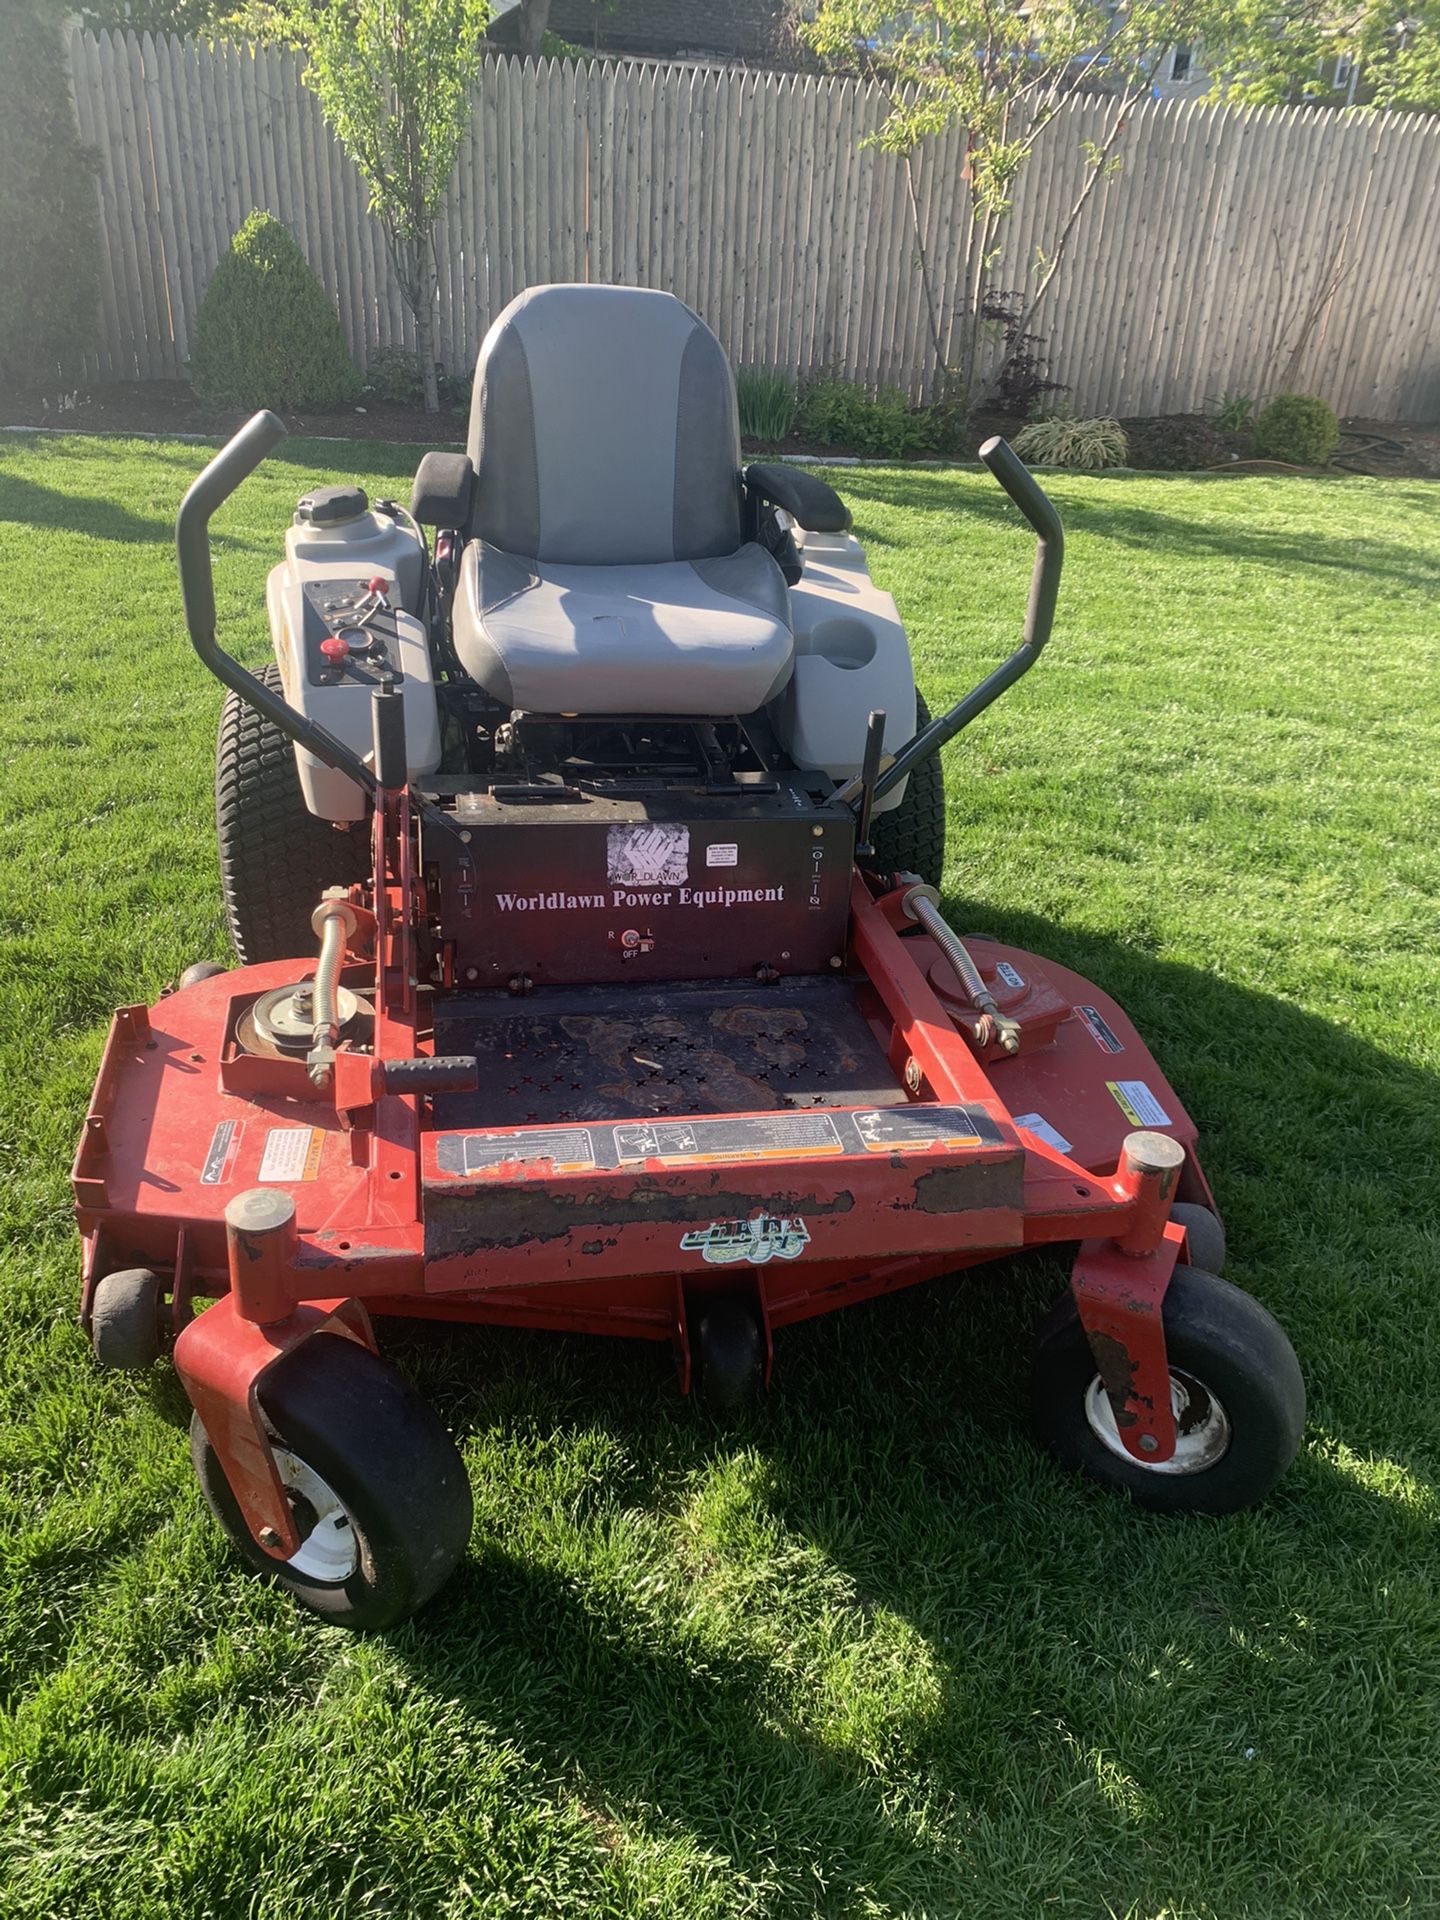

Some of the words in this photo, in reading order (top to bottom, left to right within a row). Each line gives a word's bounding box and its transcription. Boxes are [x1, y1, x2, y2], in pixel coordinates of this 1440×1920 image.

[615, 871, 681, 881] WORDLAWN
[495, 892, 606, 912] Worldlawn
[612, 889, 672, 908] Power
[678, 884, 785, 908] Equipment
[608, 930, 615, 939] R
[647, 928, 653, 936] L
[622, 949, 639, 959] OFF
